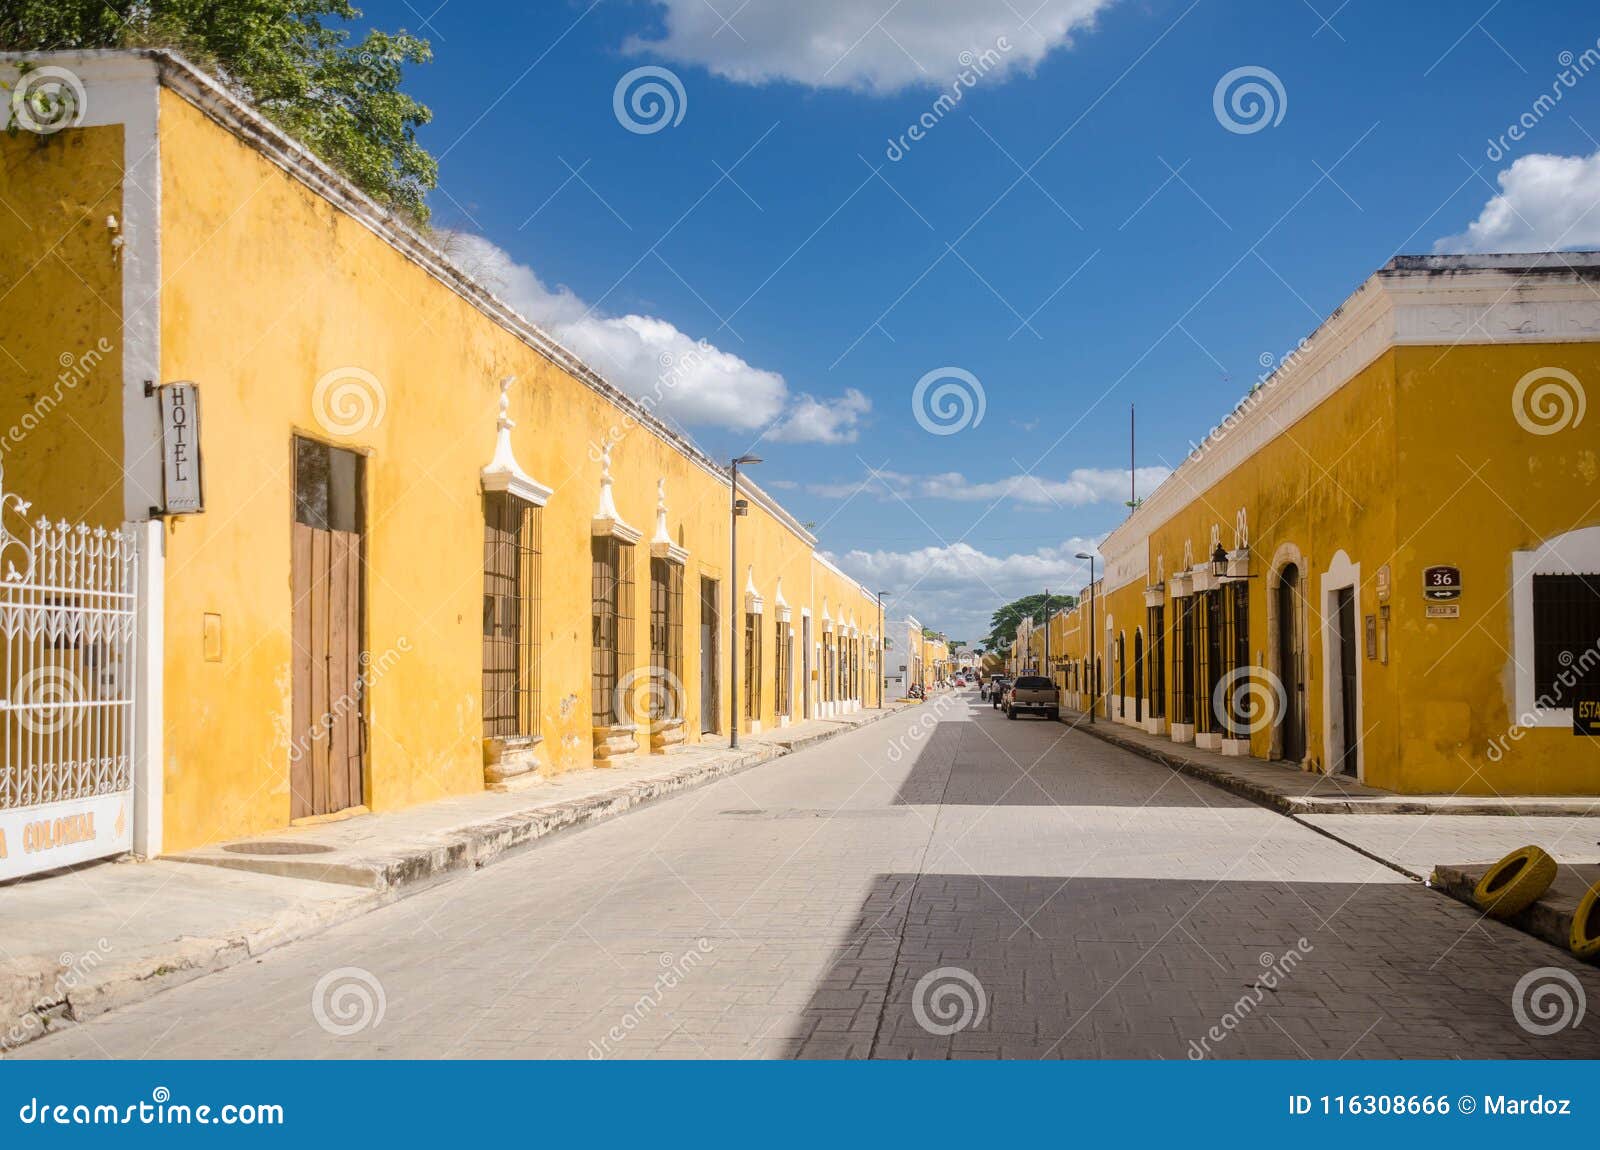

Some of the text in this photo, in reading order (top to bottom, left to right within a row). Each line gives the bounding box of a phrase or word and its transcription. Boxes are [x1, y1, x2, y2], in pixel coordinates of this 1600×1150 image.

[172, 387, 187, 481] HOTEL
[1433, 573, 1452, 585] 36
[23, 811, 96, 854] COLONIAL
